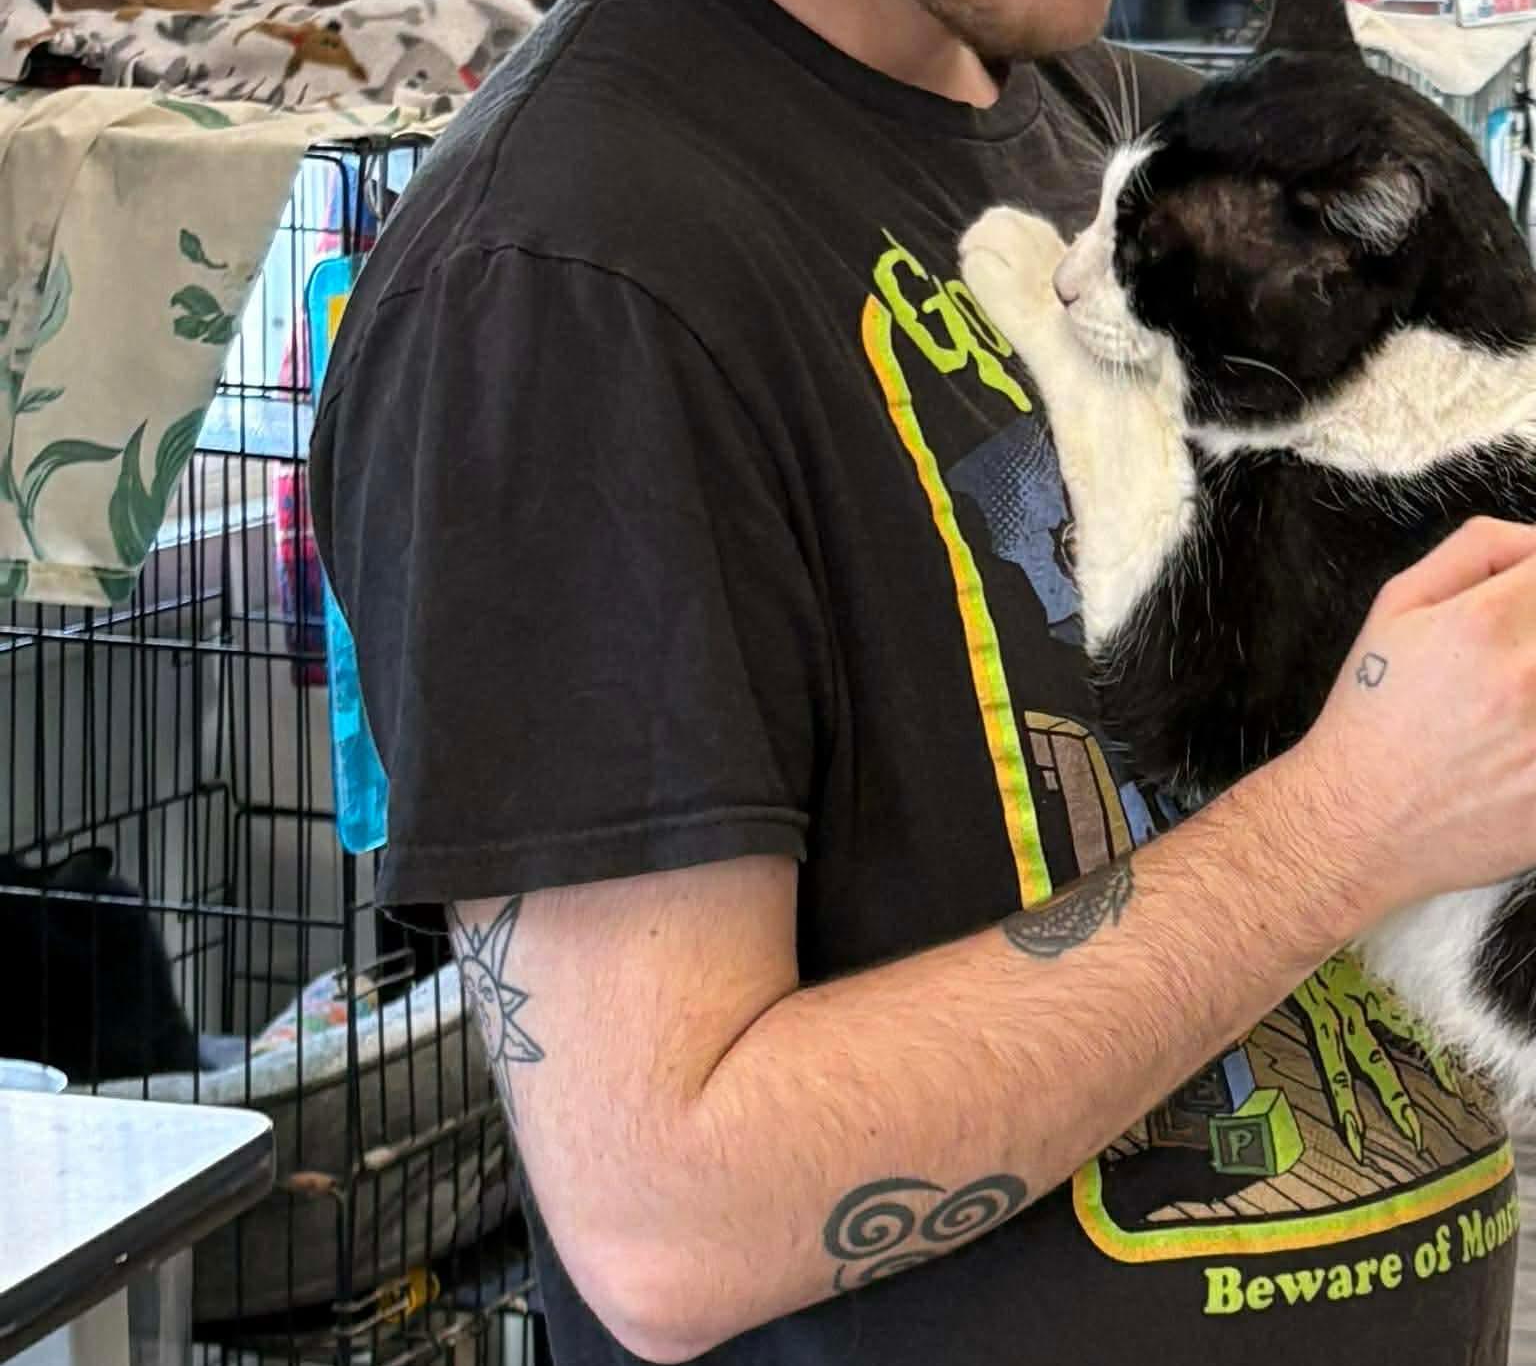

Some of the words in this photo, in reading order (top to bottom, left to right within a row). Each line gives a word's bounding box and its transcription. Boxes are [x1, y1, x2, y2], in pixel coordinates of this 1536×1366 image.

[1228, 1129, 1254, 1163] P
[1203, 1252, 1403, 1316] Beware
[1413, 1225, 1452, 1279] of
